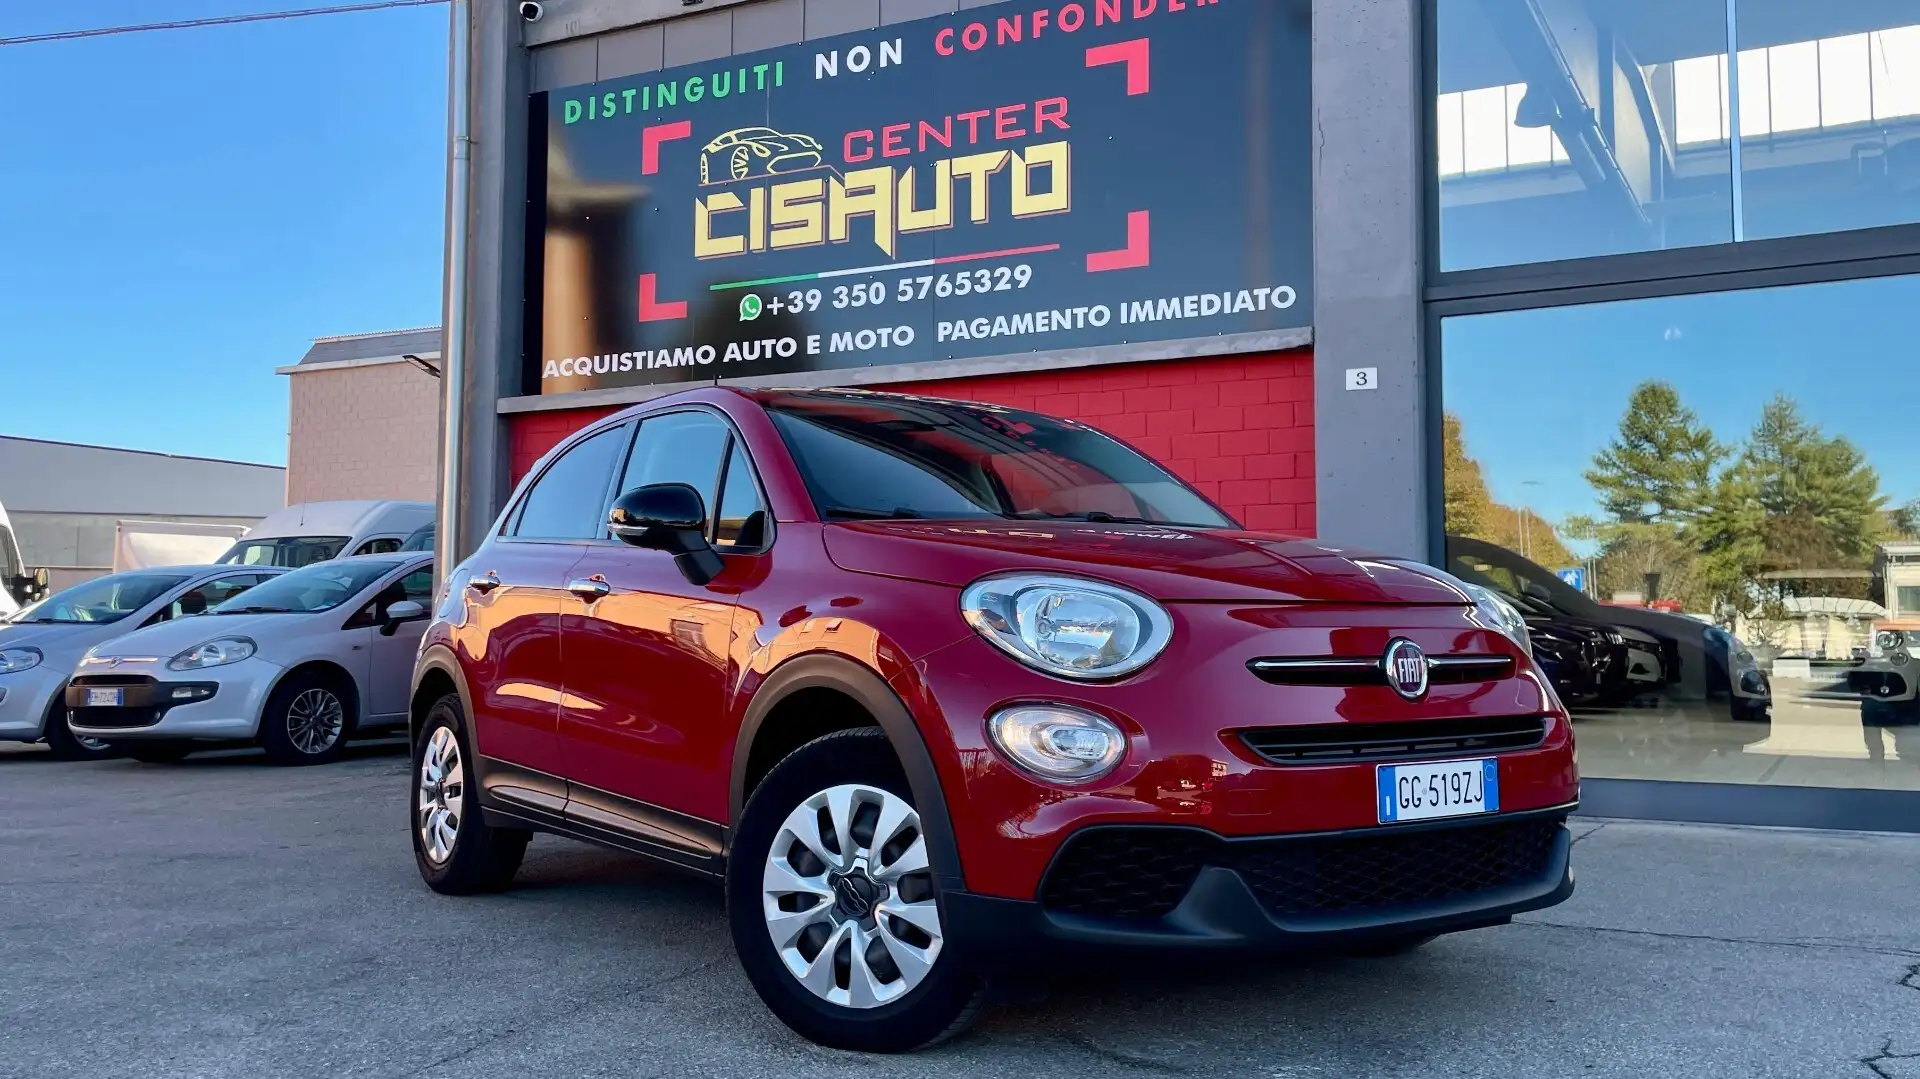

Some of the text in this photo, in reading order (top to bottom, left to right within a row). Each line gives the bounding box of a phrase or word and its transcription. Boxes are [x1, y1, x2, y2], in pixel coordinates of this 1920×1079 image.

[564, 0, 1219, 125] DISTINGUITI NON CONFOND
[843, 97, 1071, 164] CENTER
[694, 140, 1072, 260] CISAUTO
[766, 264, 1033, 317] +39 350 5765329
[541, 285, 1297, 379] ACQUISTIAMO AUTO E MOTO PAGAMENTO IMMEDIATO
[1356, 372, 1367, 385] 3
[1397, 657, 1420, 683] FIAT
[1399, 771, 1483, 809] GG 519ZJ
